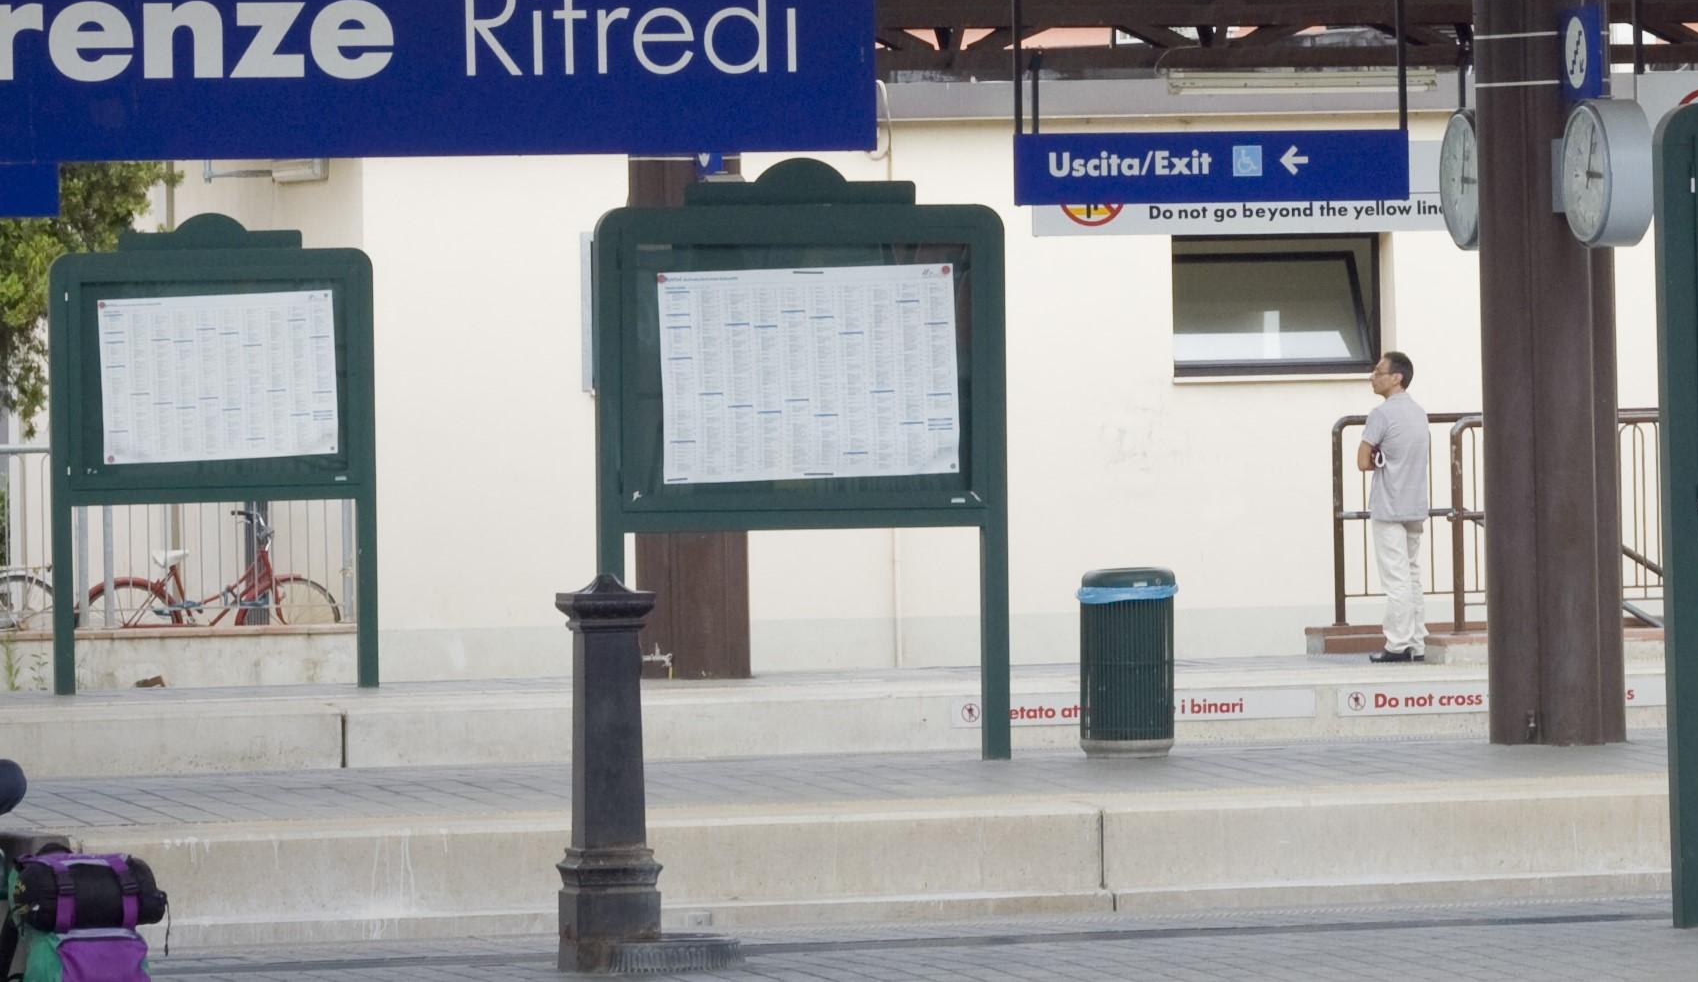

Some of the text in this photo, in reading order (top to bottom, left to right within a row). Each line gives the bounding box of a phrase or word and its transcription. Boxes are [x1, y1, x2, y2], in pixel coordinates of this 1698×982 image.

[1048, 149, 1213, 178] Uscita/Exit
[1148, 205, 1174, 221] Do
[1178, 205, 1208, 220] not
[1213, 206, 1238, 223] go
[1242, 202, 1314, 223] beyond
[1319, 201, 1349, 219] the
[1353, 200, 1412, 220] yellow
[1009, 704, 1057, 720] etato
[1180, 698, 1186, 715] i
[1190, 698, 1244, 715] binari
[1374, 692, 1483, 708] Do not cross
